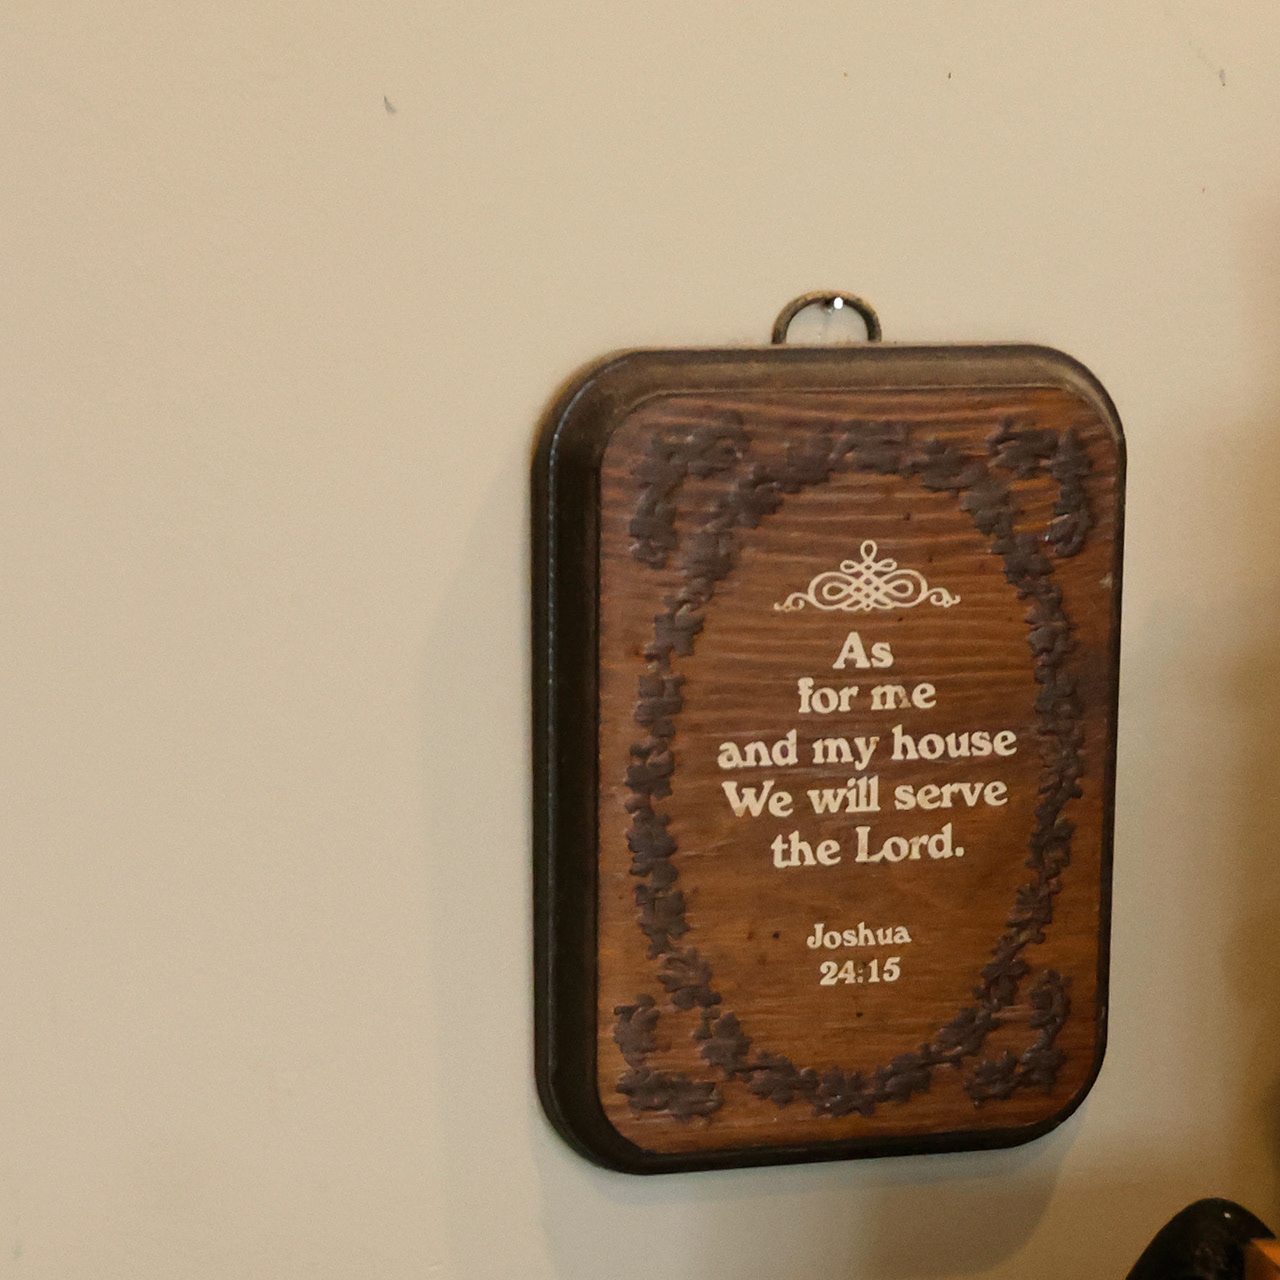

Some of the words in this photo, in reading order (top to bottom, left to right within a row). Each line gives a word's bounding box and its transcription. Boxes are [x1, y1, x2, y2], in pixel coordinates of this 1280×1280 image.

[831, 631, 894, 670] As
[797, 676, 859, 714] for
[869, 681, 937, 711] me
[717, 729, 798, 770] and
[811, 736, 880, 771] my
[891, 724, 1019, 762] house
[721, 780, 794, 818] We
[806, 777, 882, 813] will
[893, 779, 1010, 811] serve
[771, 830, 842, 869] the
[854, 824, 966, 865] Lord.
[806, 921, 913, 950] Joshua
[819, 957, 902, 987] 24:15
